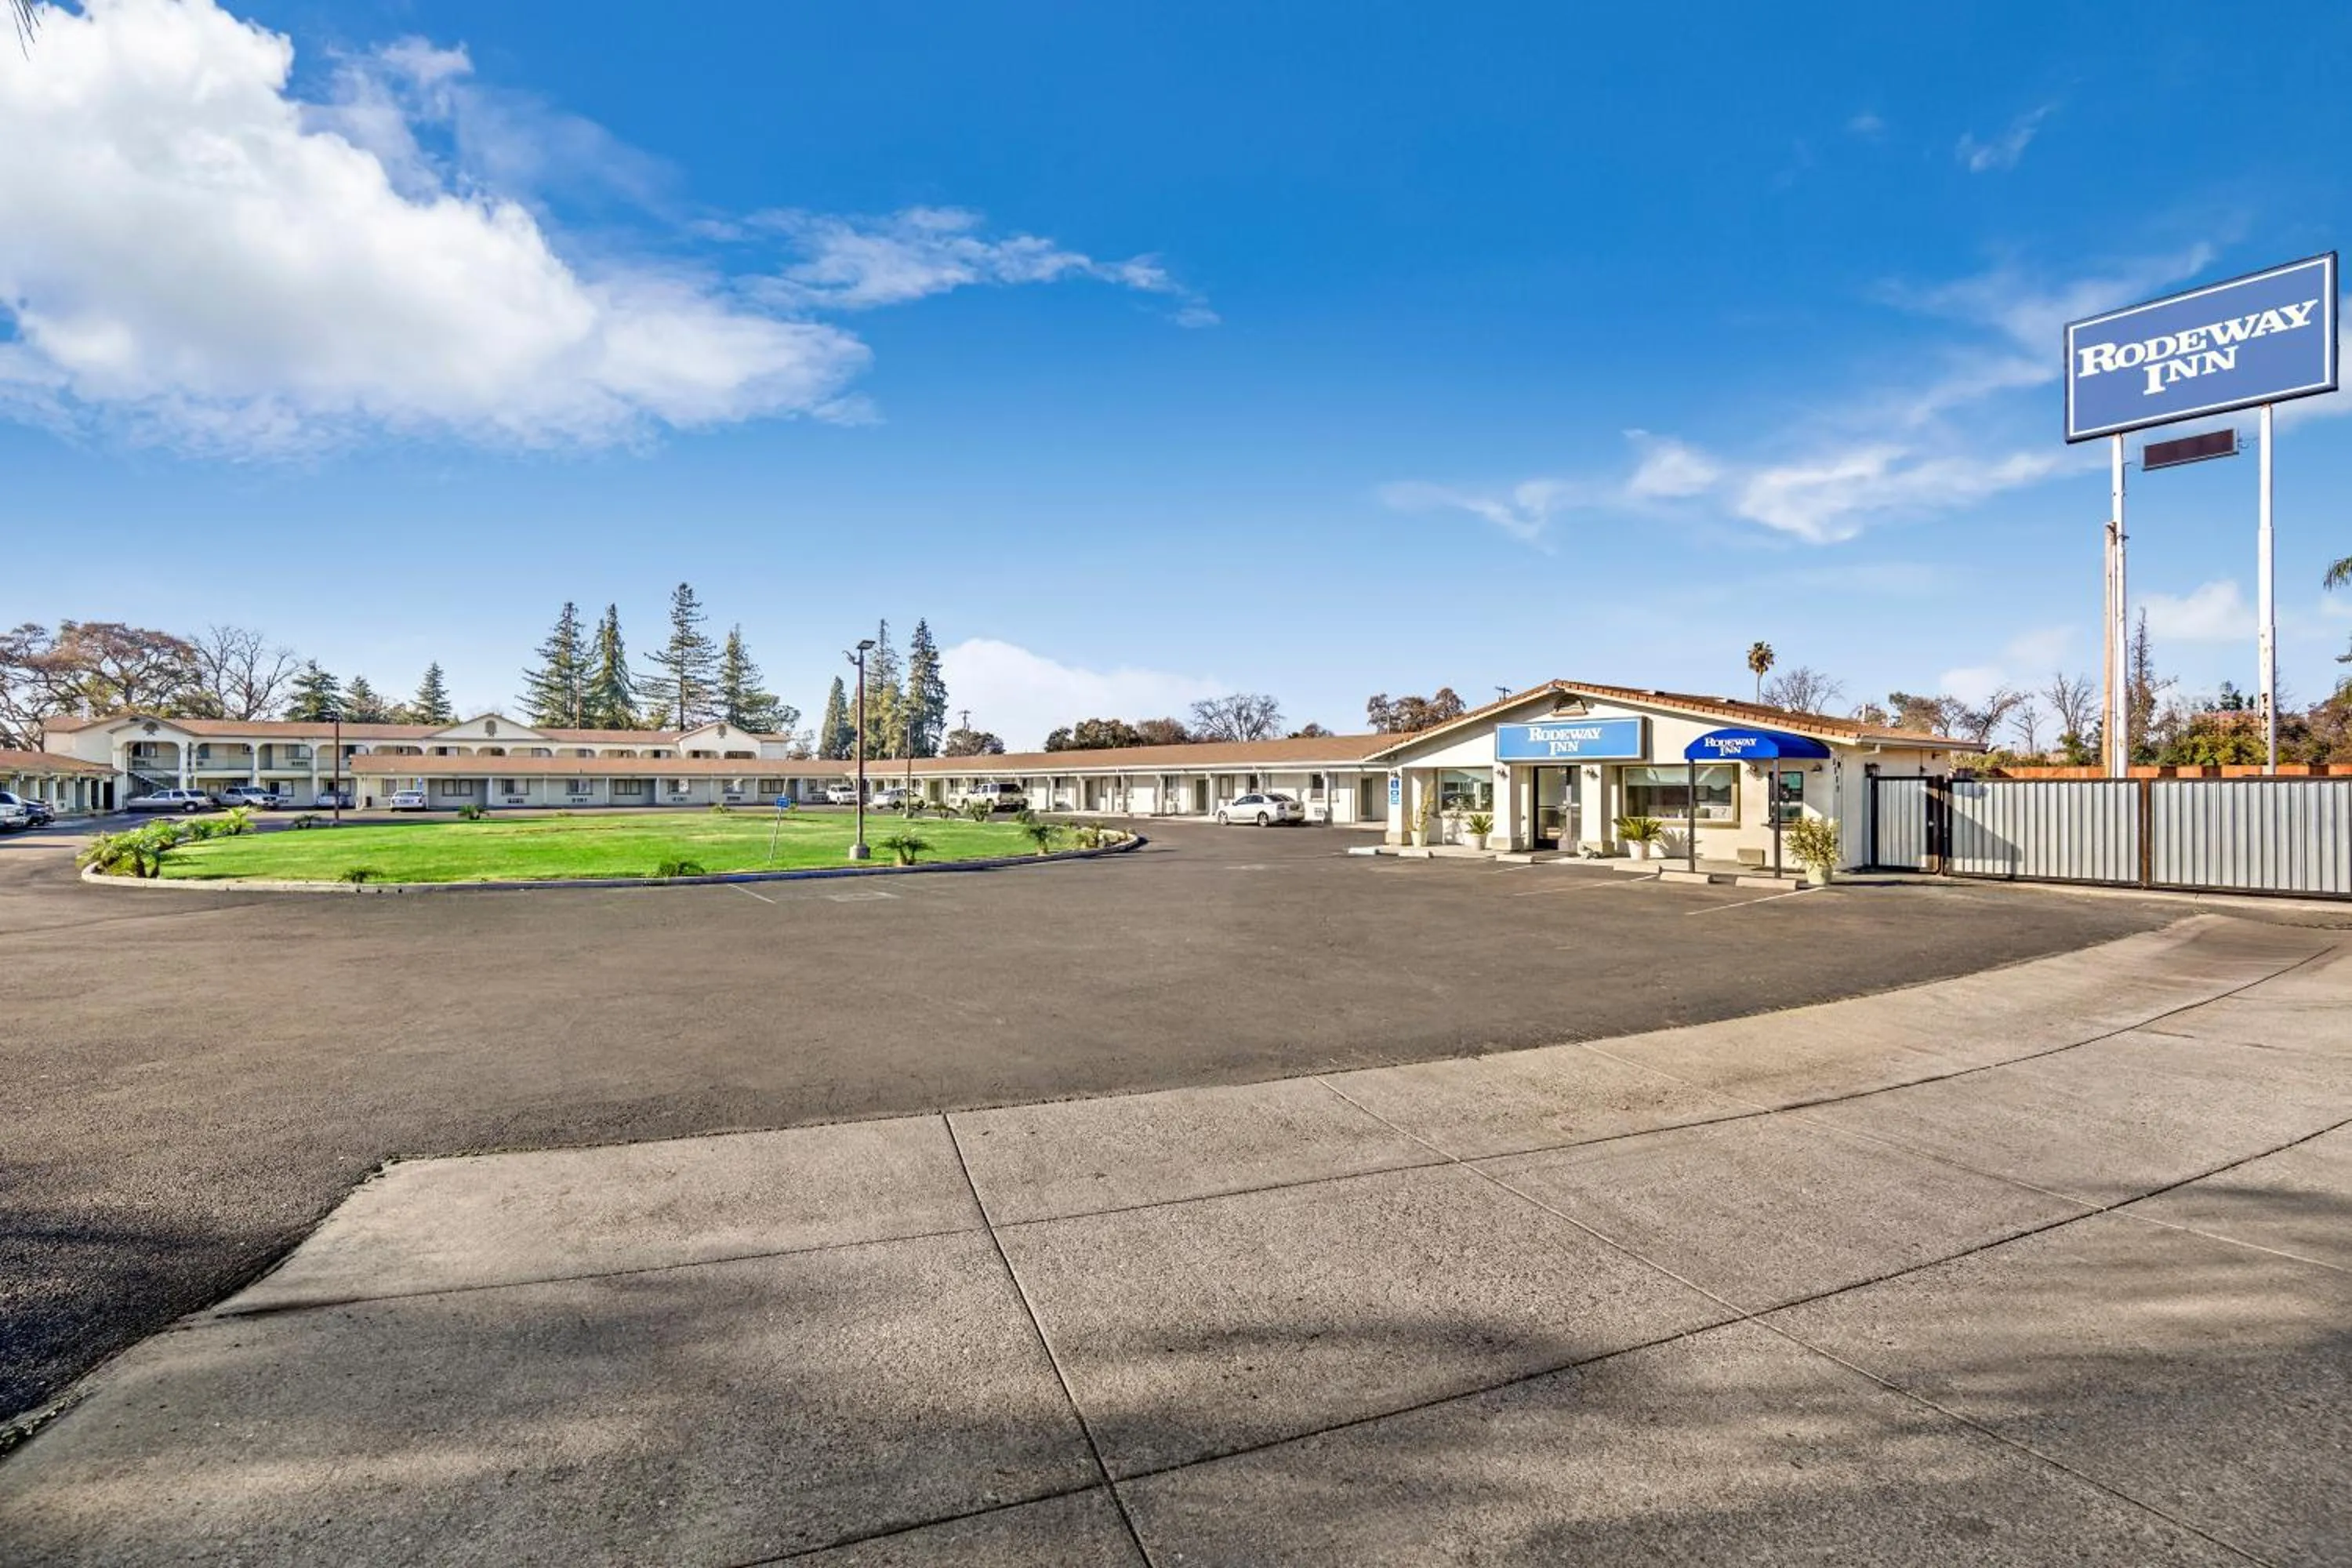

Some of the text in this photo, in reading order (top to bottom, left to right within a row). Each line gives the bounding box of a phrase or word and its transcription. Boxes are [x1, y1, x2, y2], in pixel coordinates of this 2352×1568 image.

[2078, 299, 2318, 378] RODEWAY
[2143, 345, 2240, 395] INN
[1528, 727, 1602, 742] RODEWAY
[1704, 736, 1757, 747] RODEWAY
[1549, 740, 1580, 757] INN
[1719, 746, 1741, 757] INN
